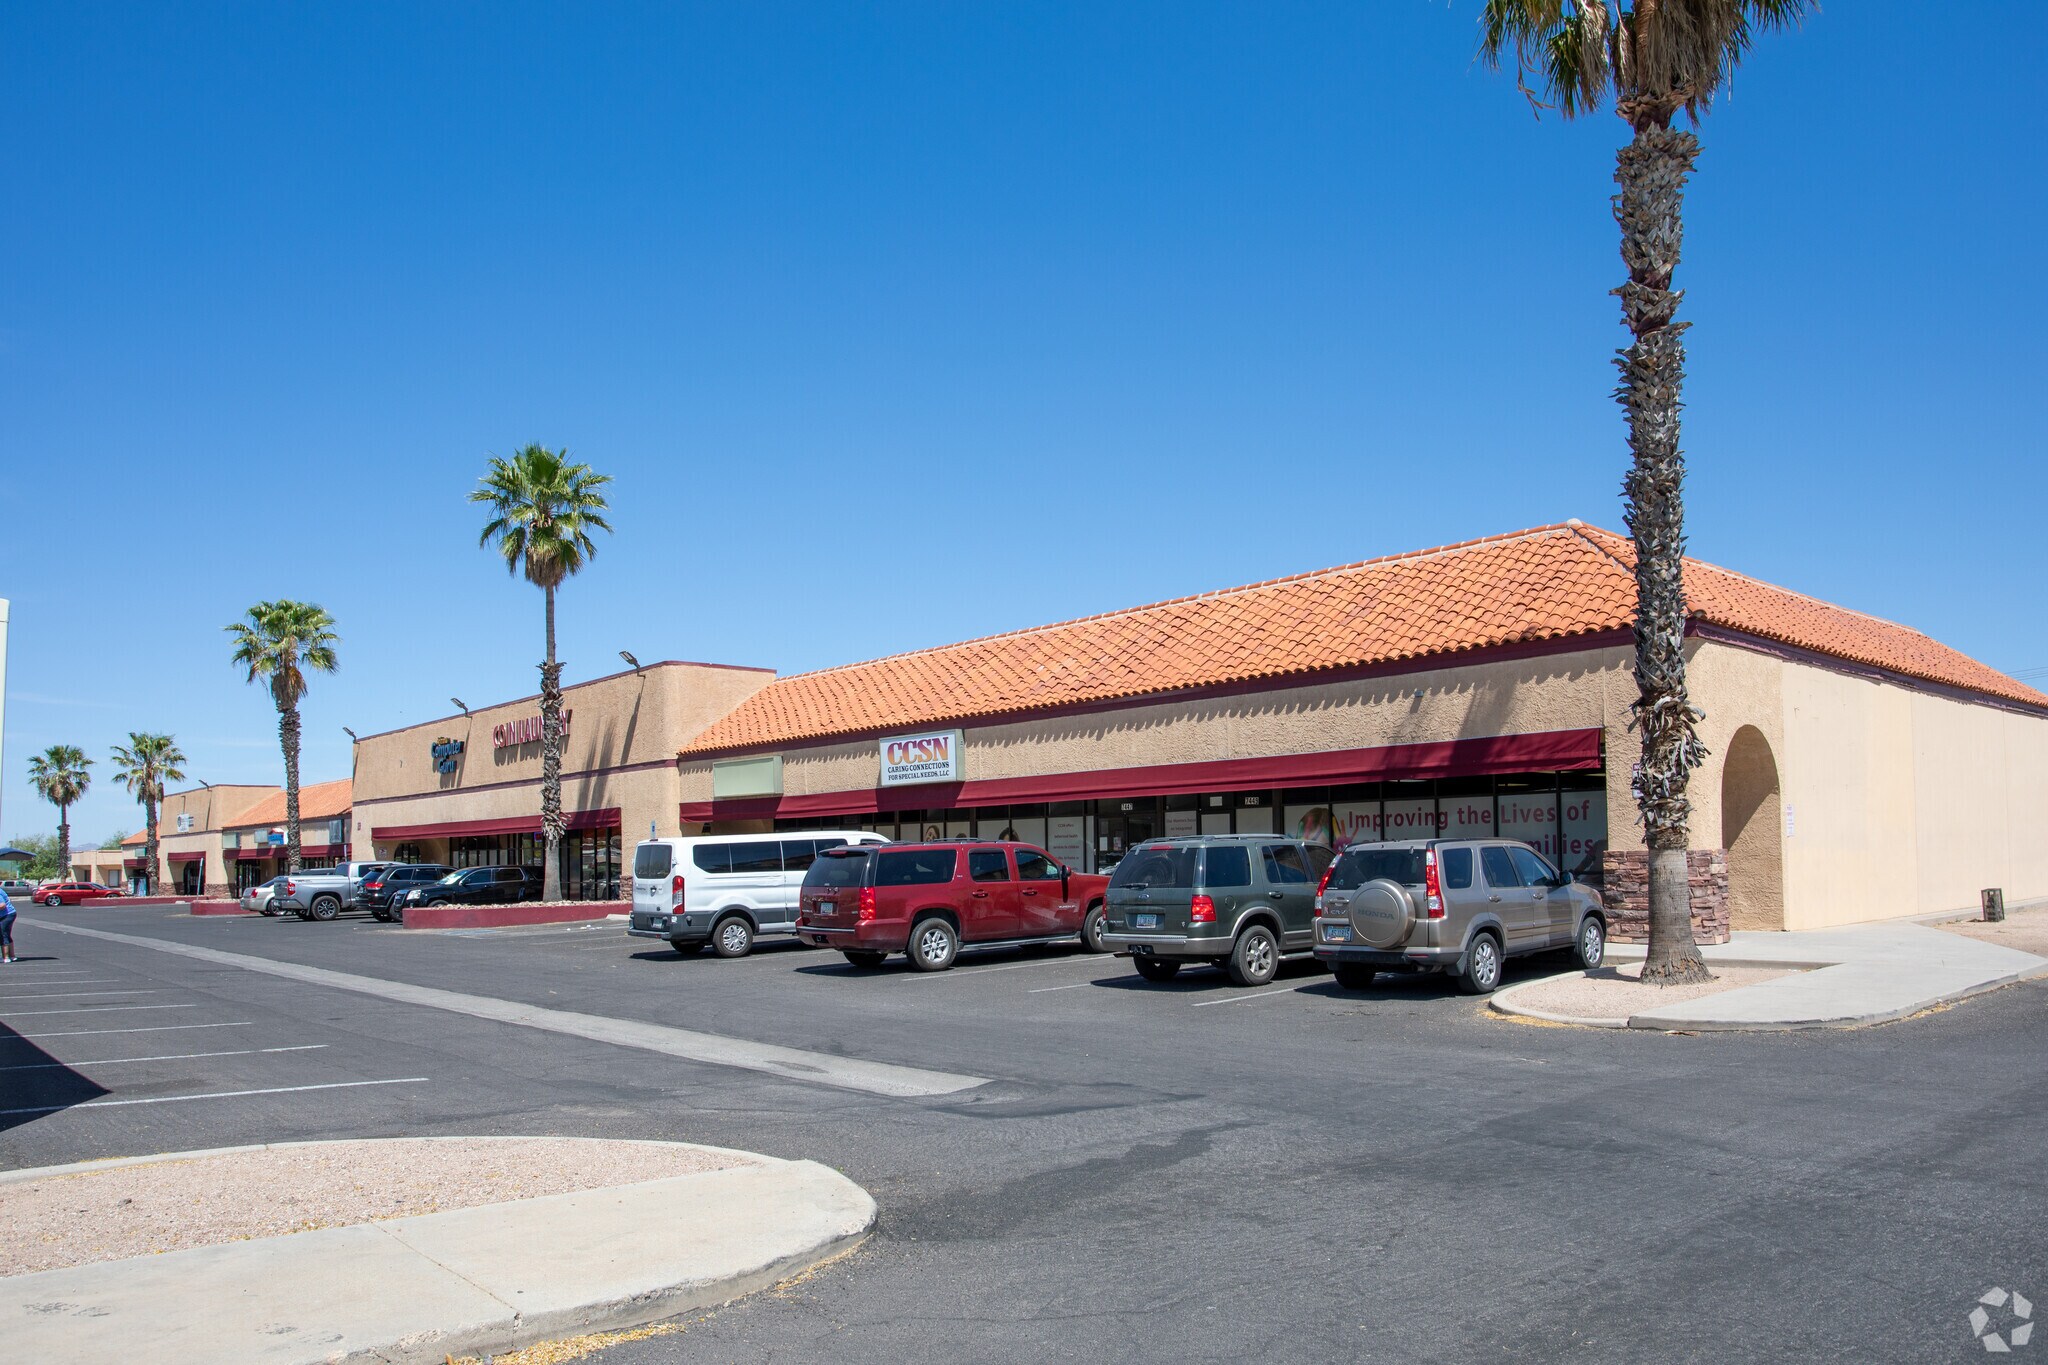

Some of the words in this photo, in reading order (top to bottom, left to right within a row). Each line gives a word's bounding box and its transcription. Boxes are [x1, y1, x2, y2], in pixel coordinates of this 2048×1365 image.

[493, 721, 517, 749] COIN
[431, 741, 464, 759] Computer
[887, 736, 949, 765] CCSN
[887, 764, 909, 774] CARING
[909, 761, 950, 772] CONNECTIONS
[888, 773, 899, 781] FOR
[899, 771, 920, 780] SPECIAL
[939, 769, 950, 777] LLC
[1348, 806, 1448, 832] Improving
[1457, 805, 1491, 825] the
[1500, 802, 1556, 824] Lives
[1566, 799, 1590, 821] of
[1357, 907, 1395, 920] HONDA
